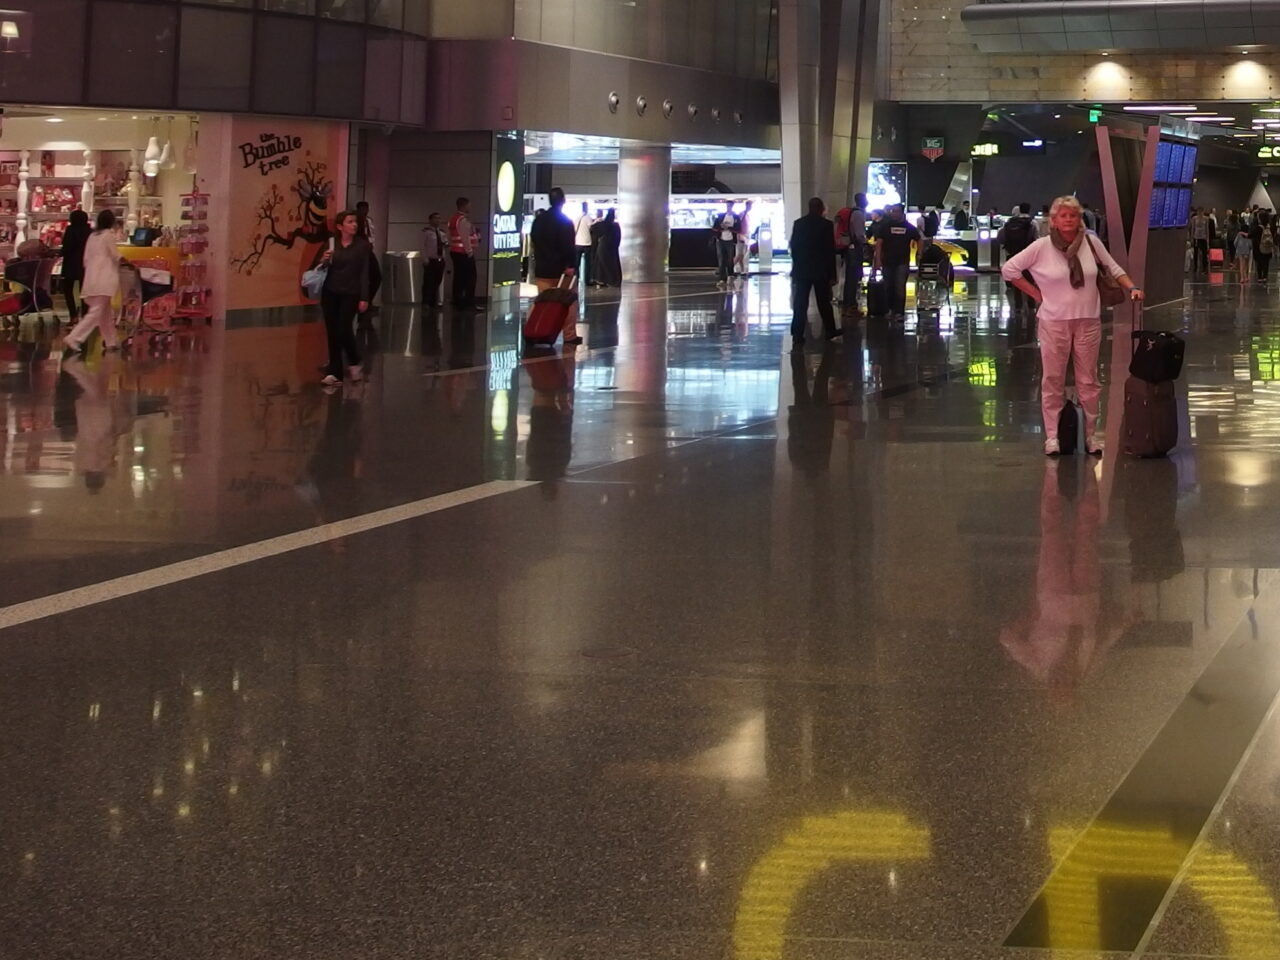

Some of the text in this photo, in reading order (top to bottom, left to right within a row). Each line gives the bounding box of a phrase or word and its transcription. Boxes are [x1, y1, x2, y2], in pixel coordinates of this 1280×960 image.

[259, 133, 276, 143] the
[238, 135, 302, 168] Bumble
[258, 155, 290, 176] tree
[494, 233, 507, 249] UTY
